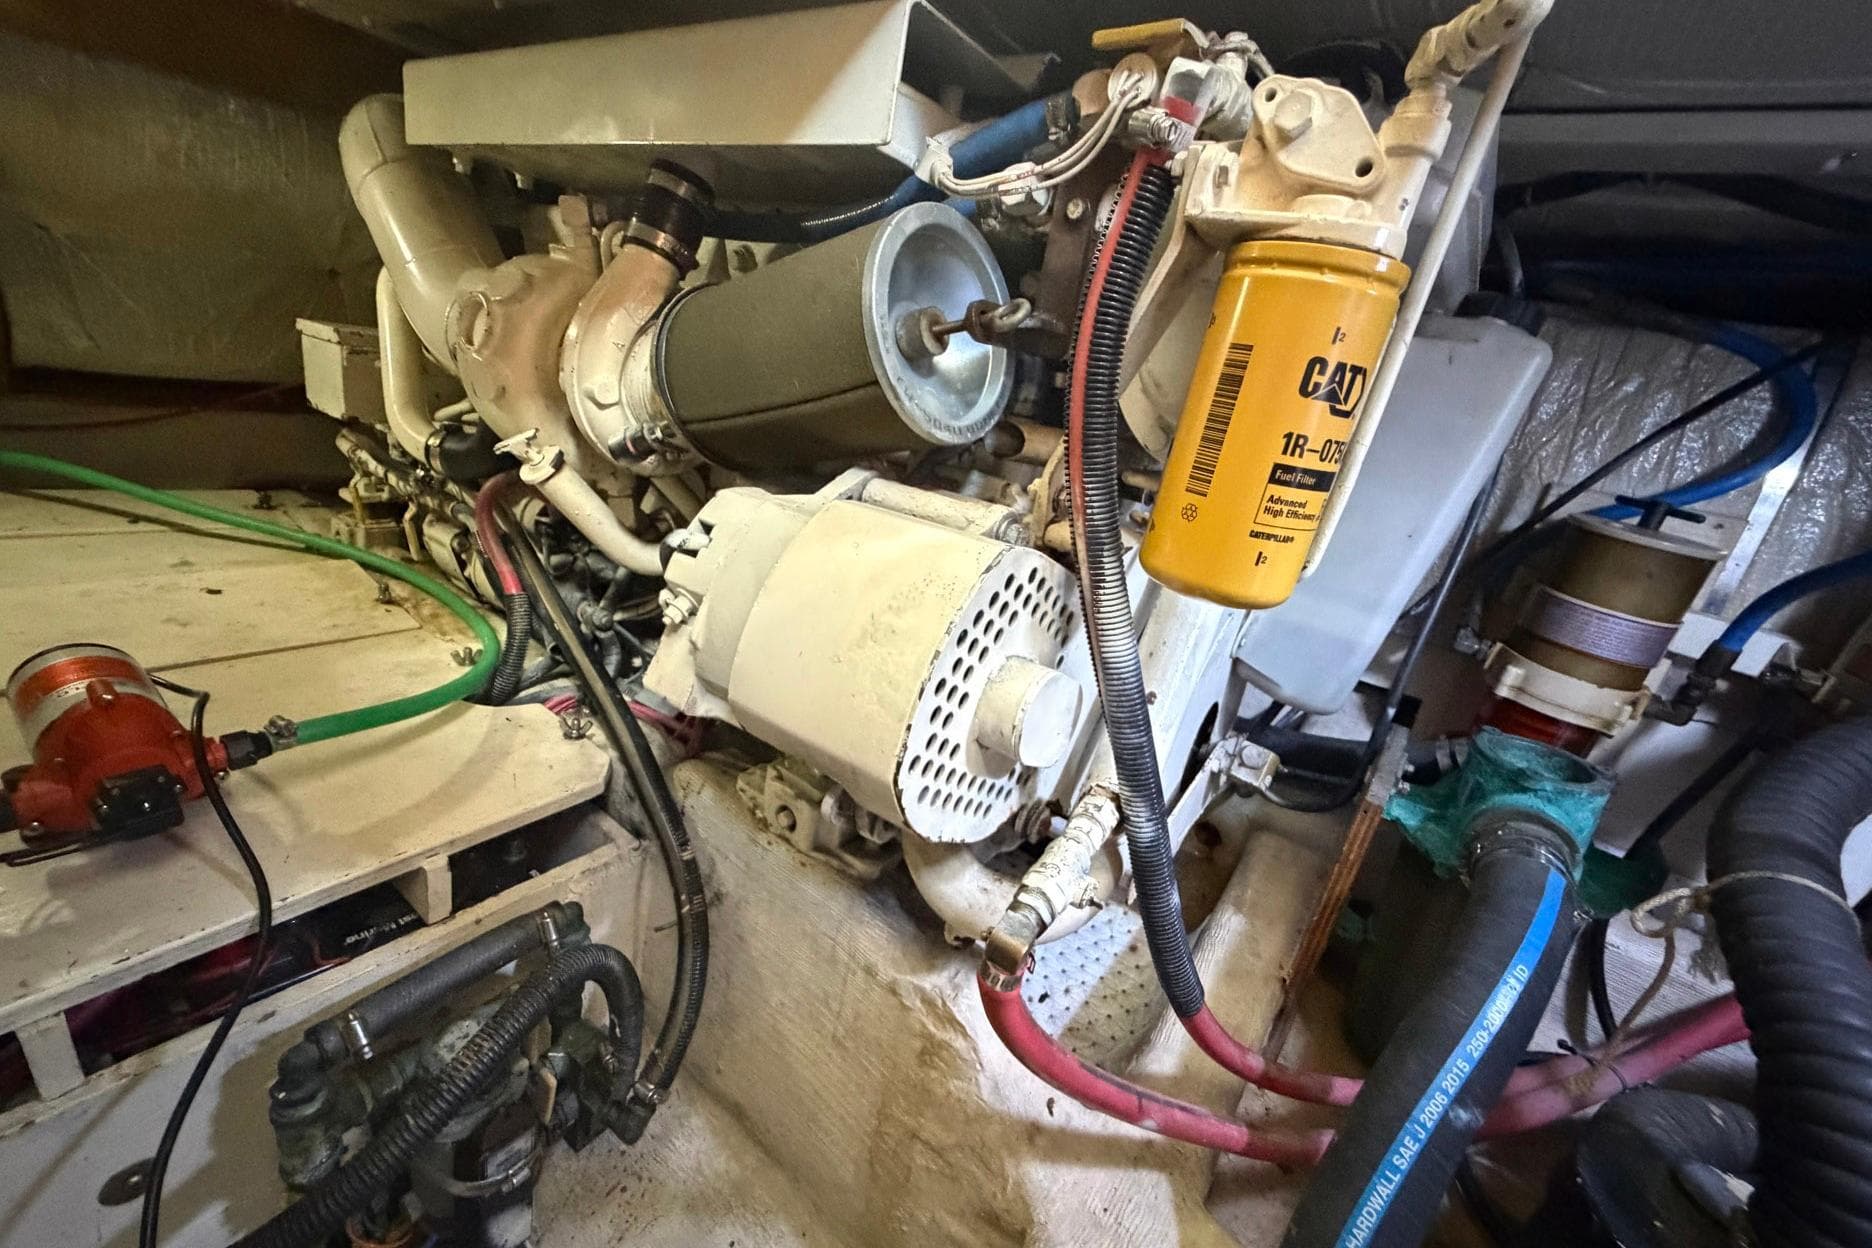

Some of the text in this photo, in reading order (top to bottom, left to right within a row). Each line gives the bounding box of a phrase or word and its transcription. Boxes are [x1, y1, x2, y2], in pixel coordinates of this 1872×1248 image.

[1298, 355, 1366, 407] CAT
[1281, 431, 1347, 464] 1R-075
[1275, 469, 1316, 486] Fuel Filter
[1263, 505, 1317, 523] High Efficiency
[1266, 494, 1308, 509] Advanced
[1345, 1169, 1400, 1248] HARDWALL
[1392, 1135, 1420, 1169] SAE
[1413, 1123, 1426, 1140] J
[1420, 1091, 1448, 1128] 2006
[1442, 1057, 1470, 1094] 2015
[1512, 964, 1529, 983] ID
